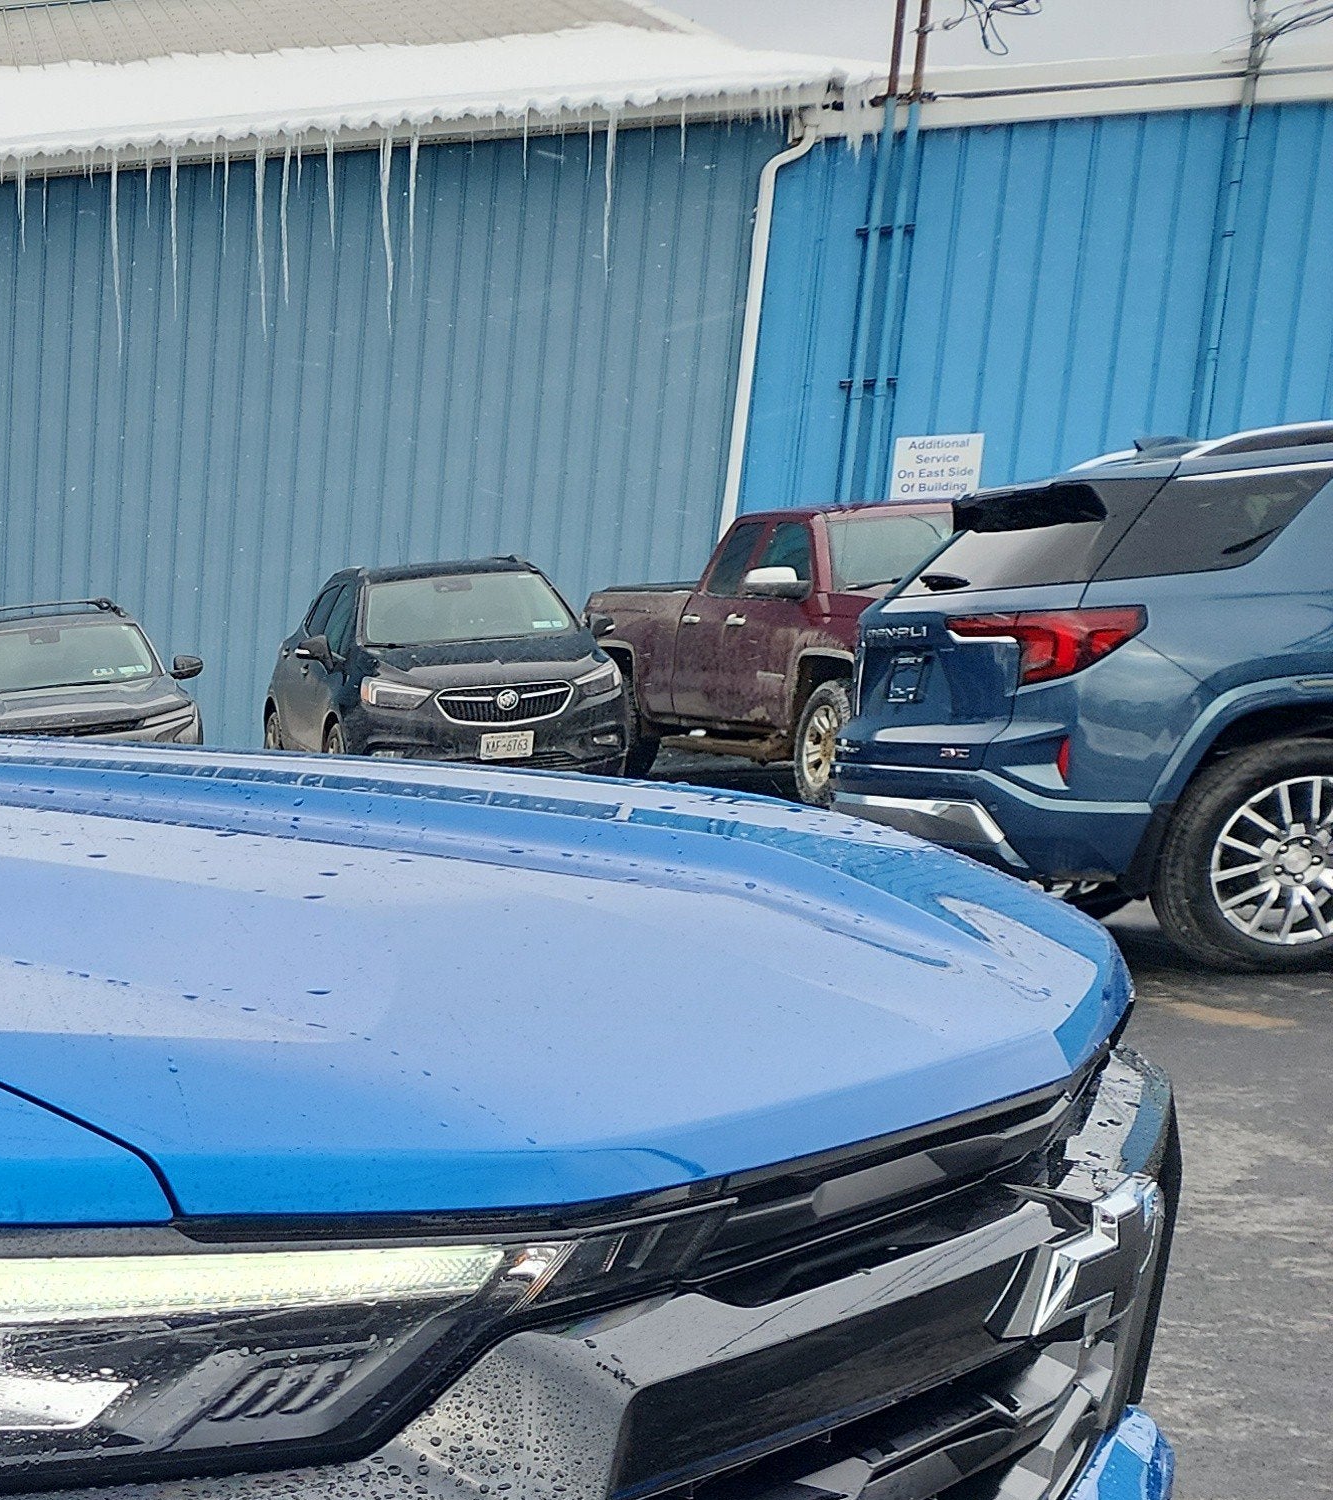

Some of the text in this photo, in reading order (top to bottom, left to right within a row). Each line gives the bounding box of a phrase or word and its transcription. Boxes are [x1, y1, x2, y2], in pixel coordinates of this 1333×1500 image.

[908, 438, 970, 450] Additional
[916, 454, 960, 464] Service
[897, 467, 974, 479] On East Side
[900, 482, 968, 493] Of Building
